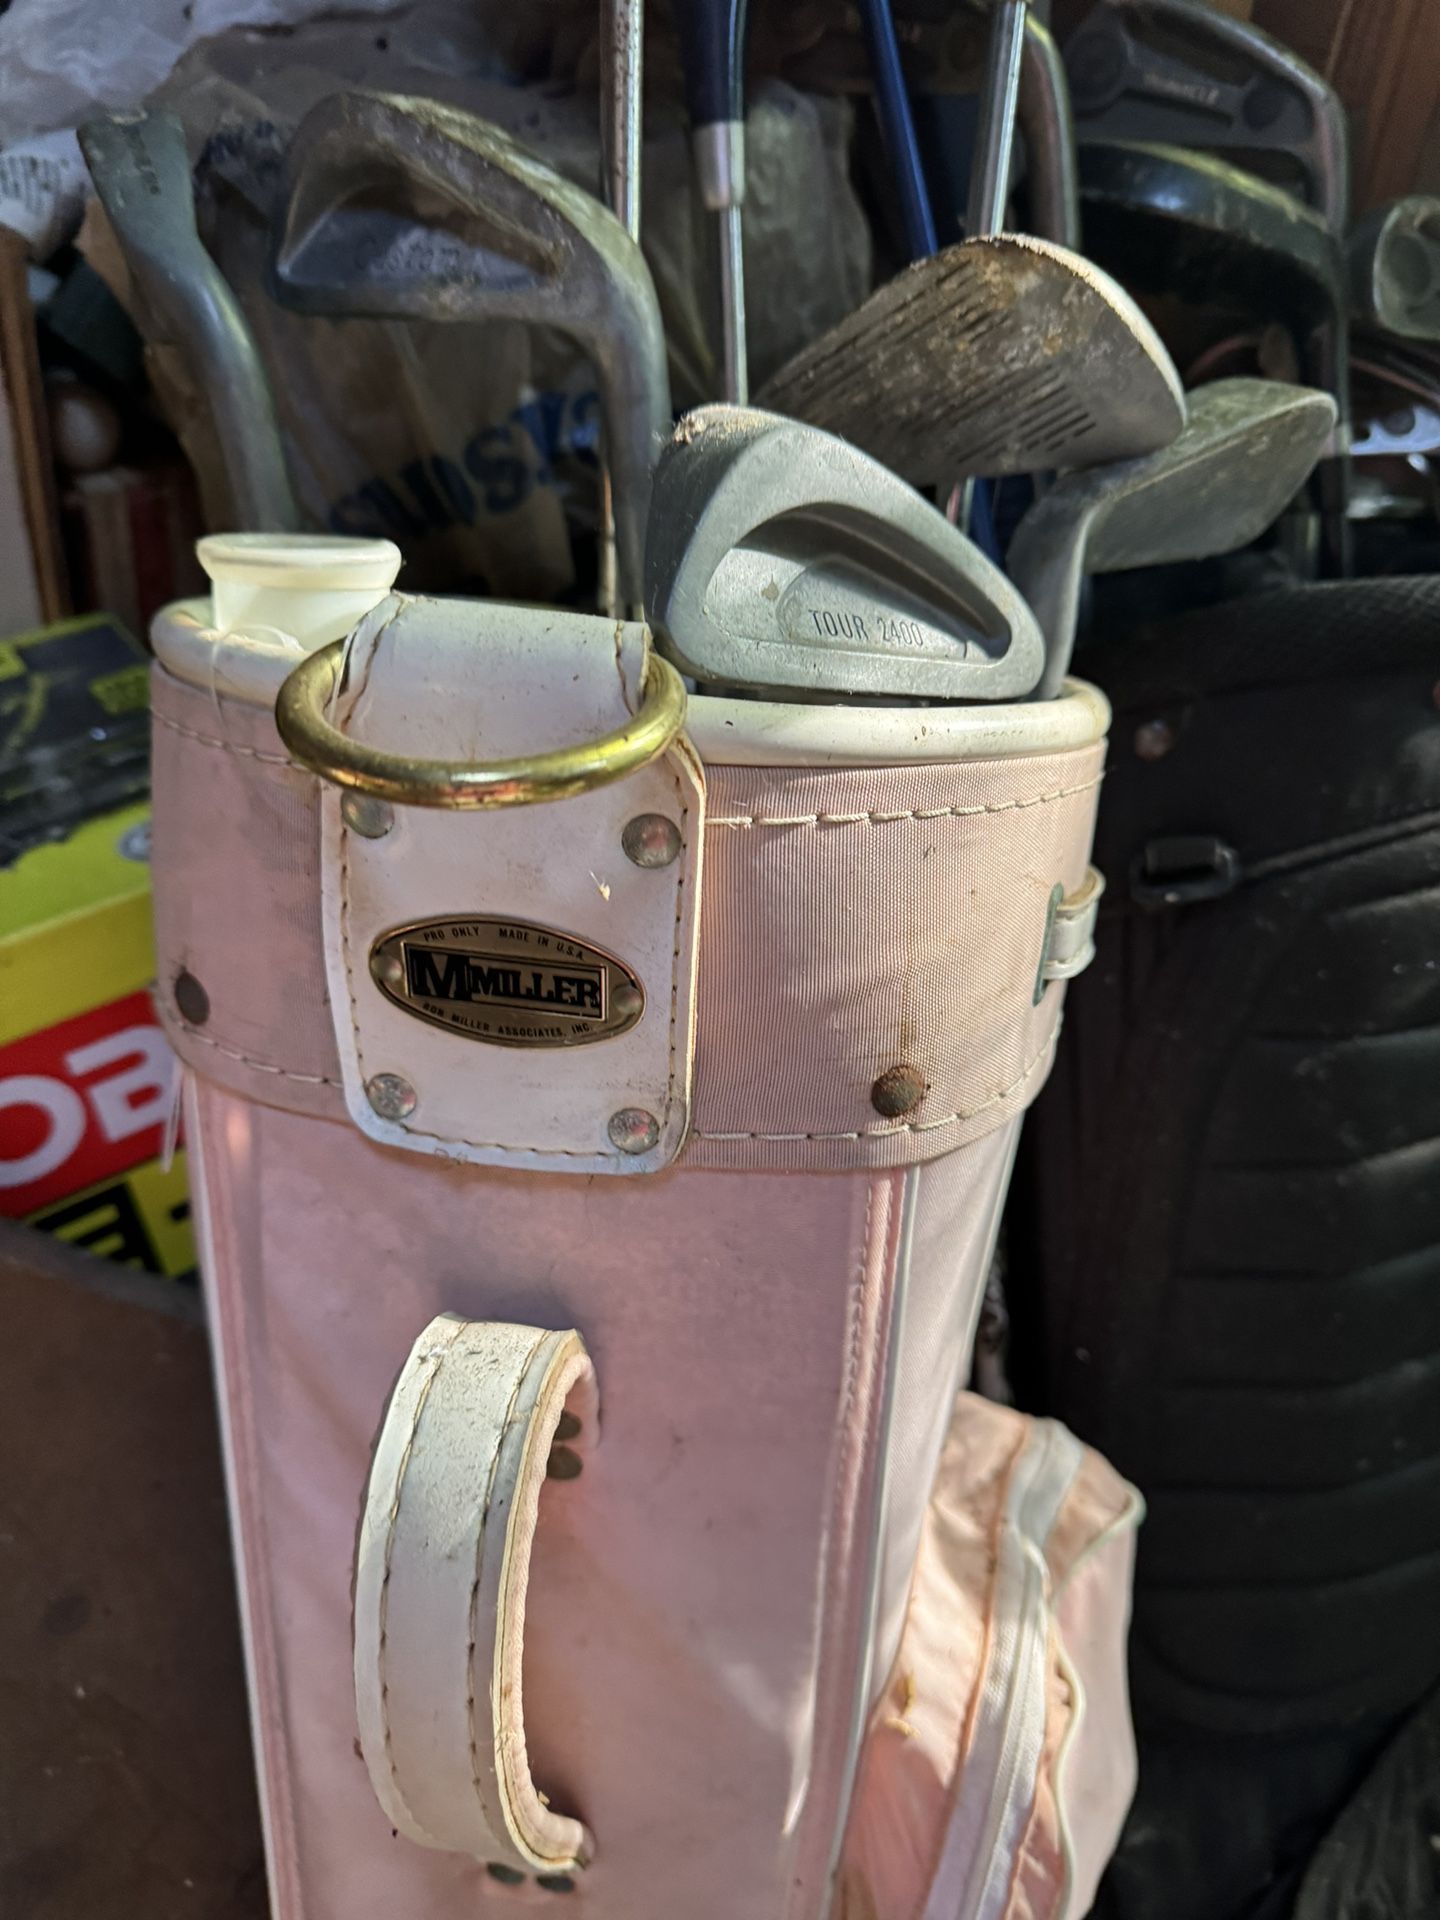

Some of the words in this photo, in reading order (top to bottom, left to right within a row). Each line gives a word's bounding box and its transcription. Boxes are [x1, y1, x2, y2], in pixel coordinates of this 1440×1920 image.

[808, 610, 868, 640] TOUR
[877, 617, 923, 646] 2400
[424, 931, 445, 943] PRO
[452, 926, 480, 938] ONLY
[499, 927, 530, 942] MADE
[538, 935, 549, 947] IN
[471, 967, 600, 1008] MILLER
[422, 1002, 445, 1018] RON
[451, 1012, 490, 1032] MILLER
